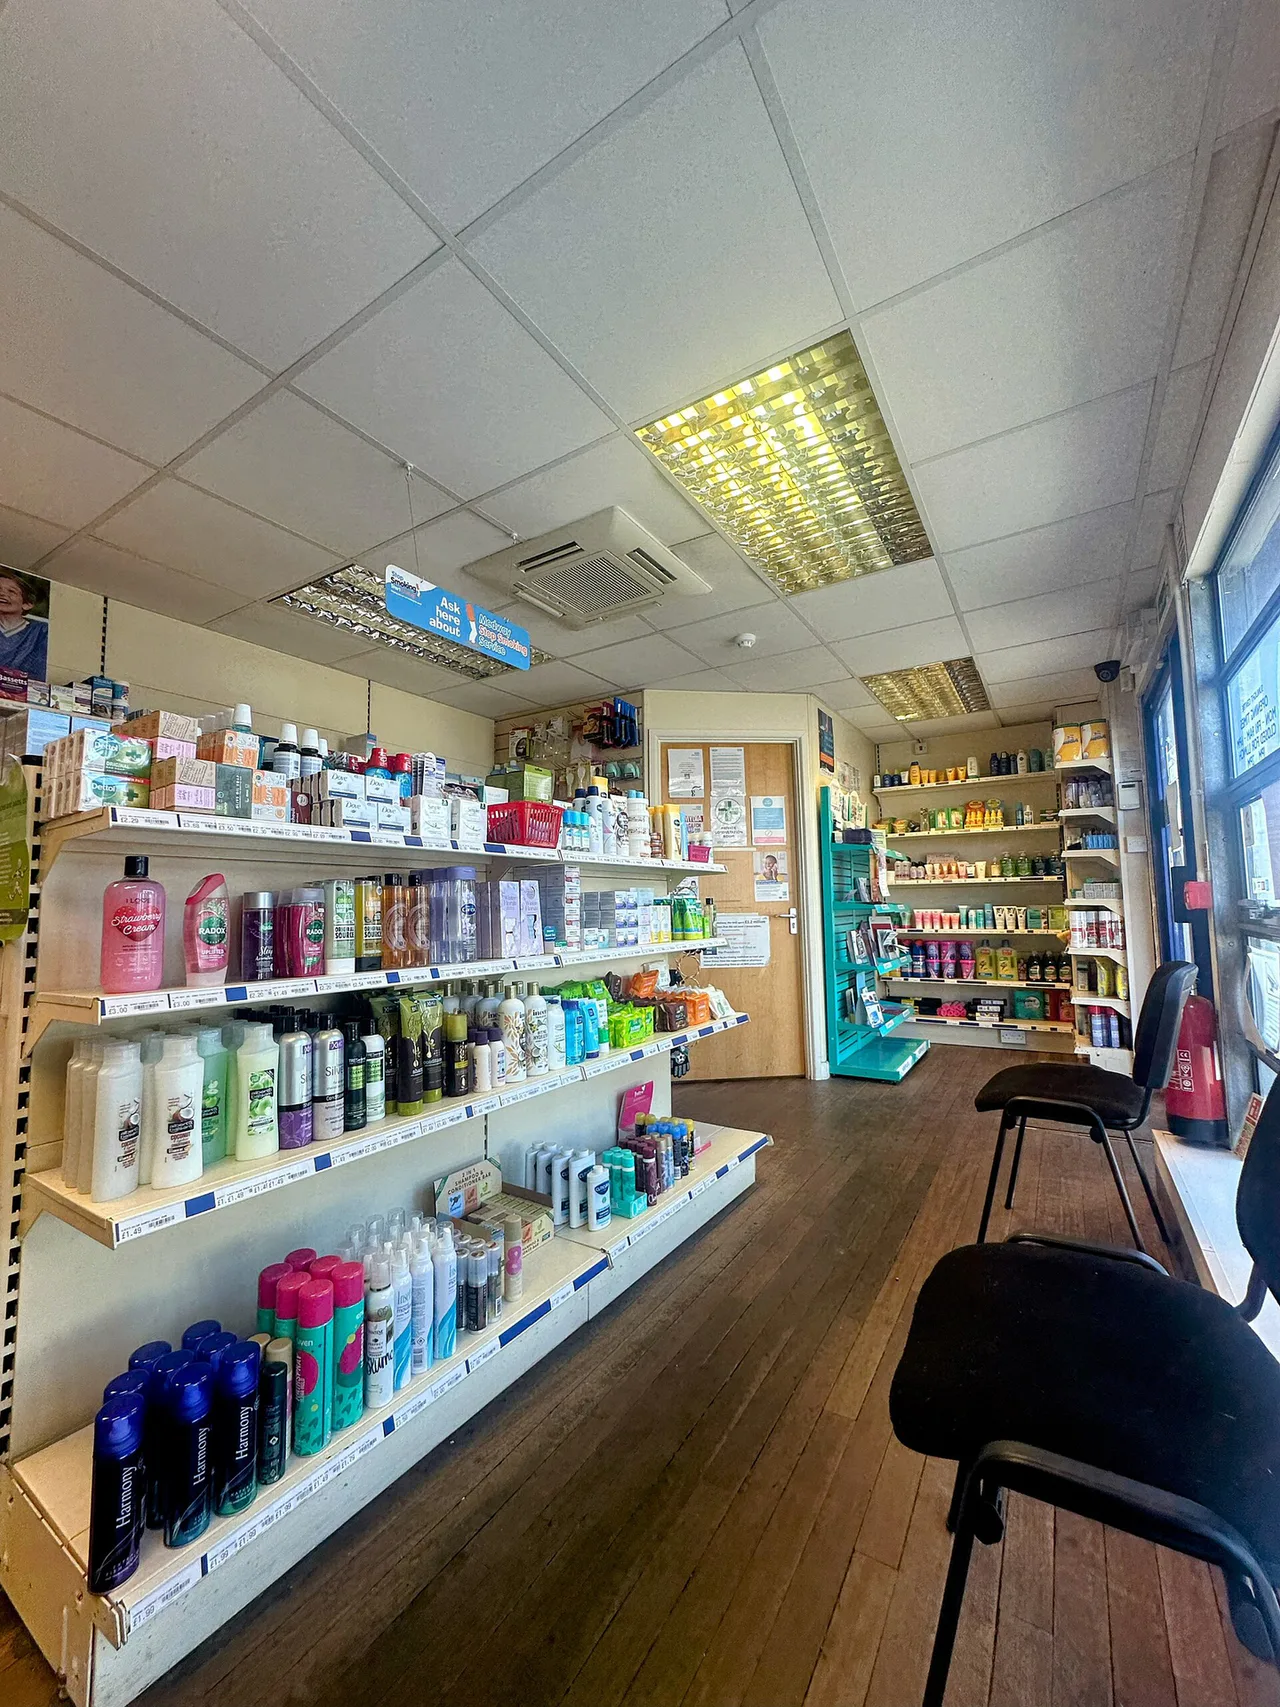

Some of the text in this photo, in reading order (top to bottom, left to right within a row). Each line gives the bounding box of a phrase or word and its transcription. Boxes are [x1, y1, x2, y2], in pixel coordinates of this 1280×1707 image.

[390, 576, 416, 593] Smoking
[440, 596, 460, 614] Ask
[436, 605, 460, 626] here
[428, 617, 460, 638] about
[479, 625, 528, 657] Stop Smoking
[479, 636, 506, 656] Service
[331, 772, 348, 782] Dove
[369, 779, 384, 788] Dove
[92, 782, 116, 792] Dettol
[345, 800, 362, 809] Dove
[381, 806, 396, 814] Dove
[110, 912, 162, 927] Strawberry
[122, 922, 156, 935] Cream
[448, 1172, 491, 1195] CONDITIONER BAR
[455, 1172, 479, 1186] SHAMPOO
[228, 1192, 244, 1203] £1.49
[121, 1227, 142, 1240] £1.49
[236, 1406, 253, 1460] Harmony
[194, 1427, 210, 1486] Harmony
[313, 1474, 329, 1490] £1.49
[116, 1466, 137, 1529] Harmony
[275, 1503, 292, 1520] £1.99
[238, 1530, 257, 1548] £1.99
[210, 1550, 229, 1569] £1.99
[133, 1605, 155, 1627] £1.99
